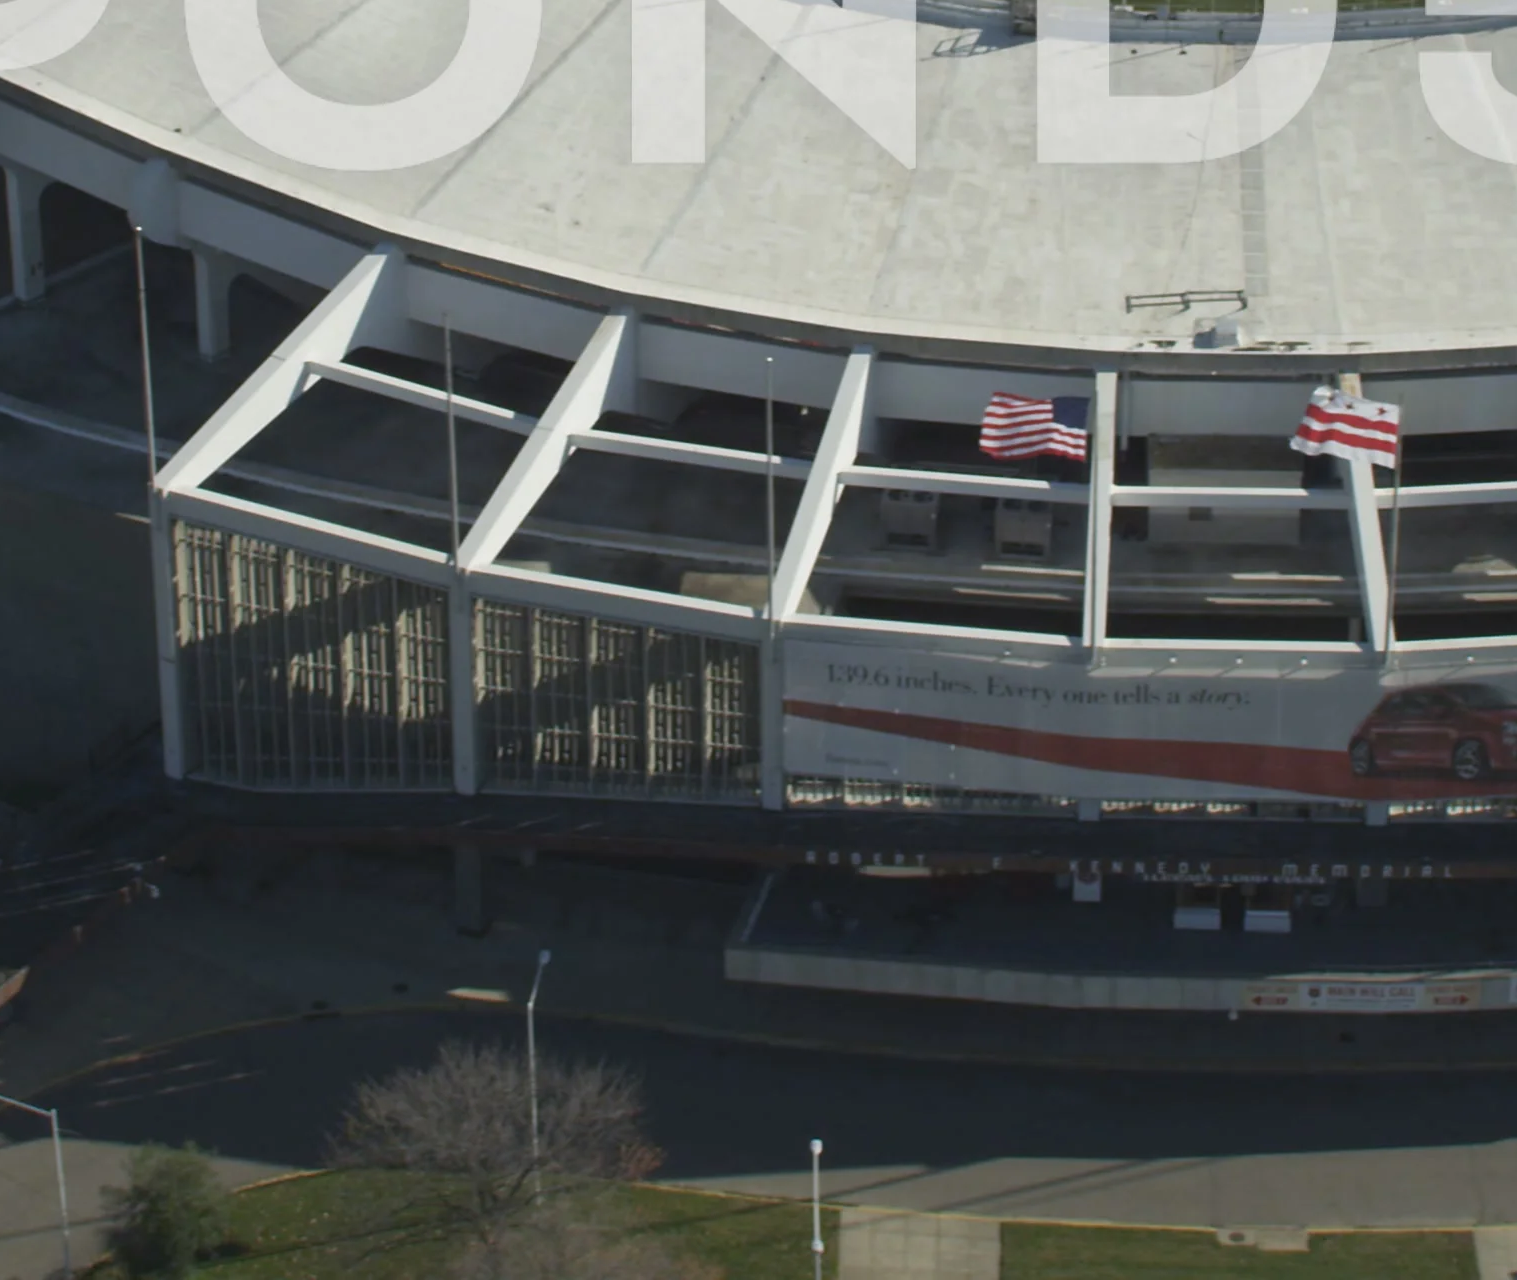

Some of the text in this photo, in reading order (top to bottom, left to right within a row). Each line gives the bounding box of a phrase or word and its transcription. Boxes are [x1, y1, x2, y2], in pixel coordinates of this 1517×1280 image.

[827, 663, 889, 687] 139.6
[896, 670, 978, 695] inches.
[987, 674, 1052, 708] Every
[1062, 690, 1107, 705] one
[1113, 684, 1160, 705] tells
[1167, 691, 1180, 705] a
[805, 851, 927, 866] ROBERT
[1069, 859, 1210, 875] KENNEDY
[1282, 863, 1454, 878] MEMORIAL
